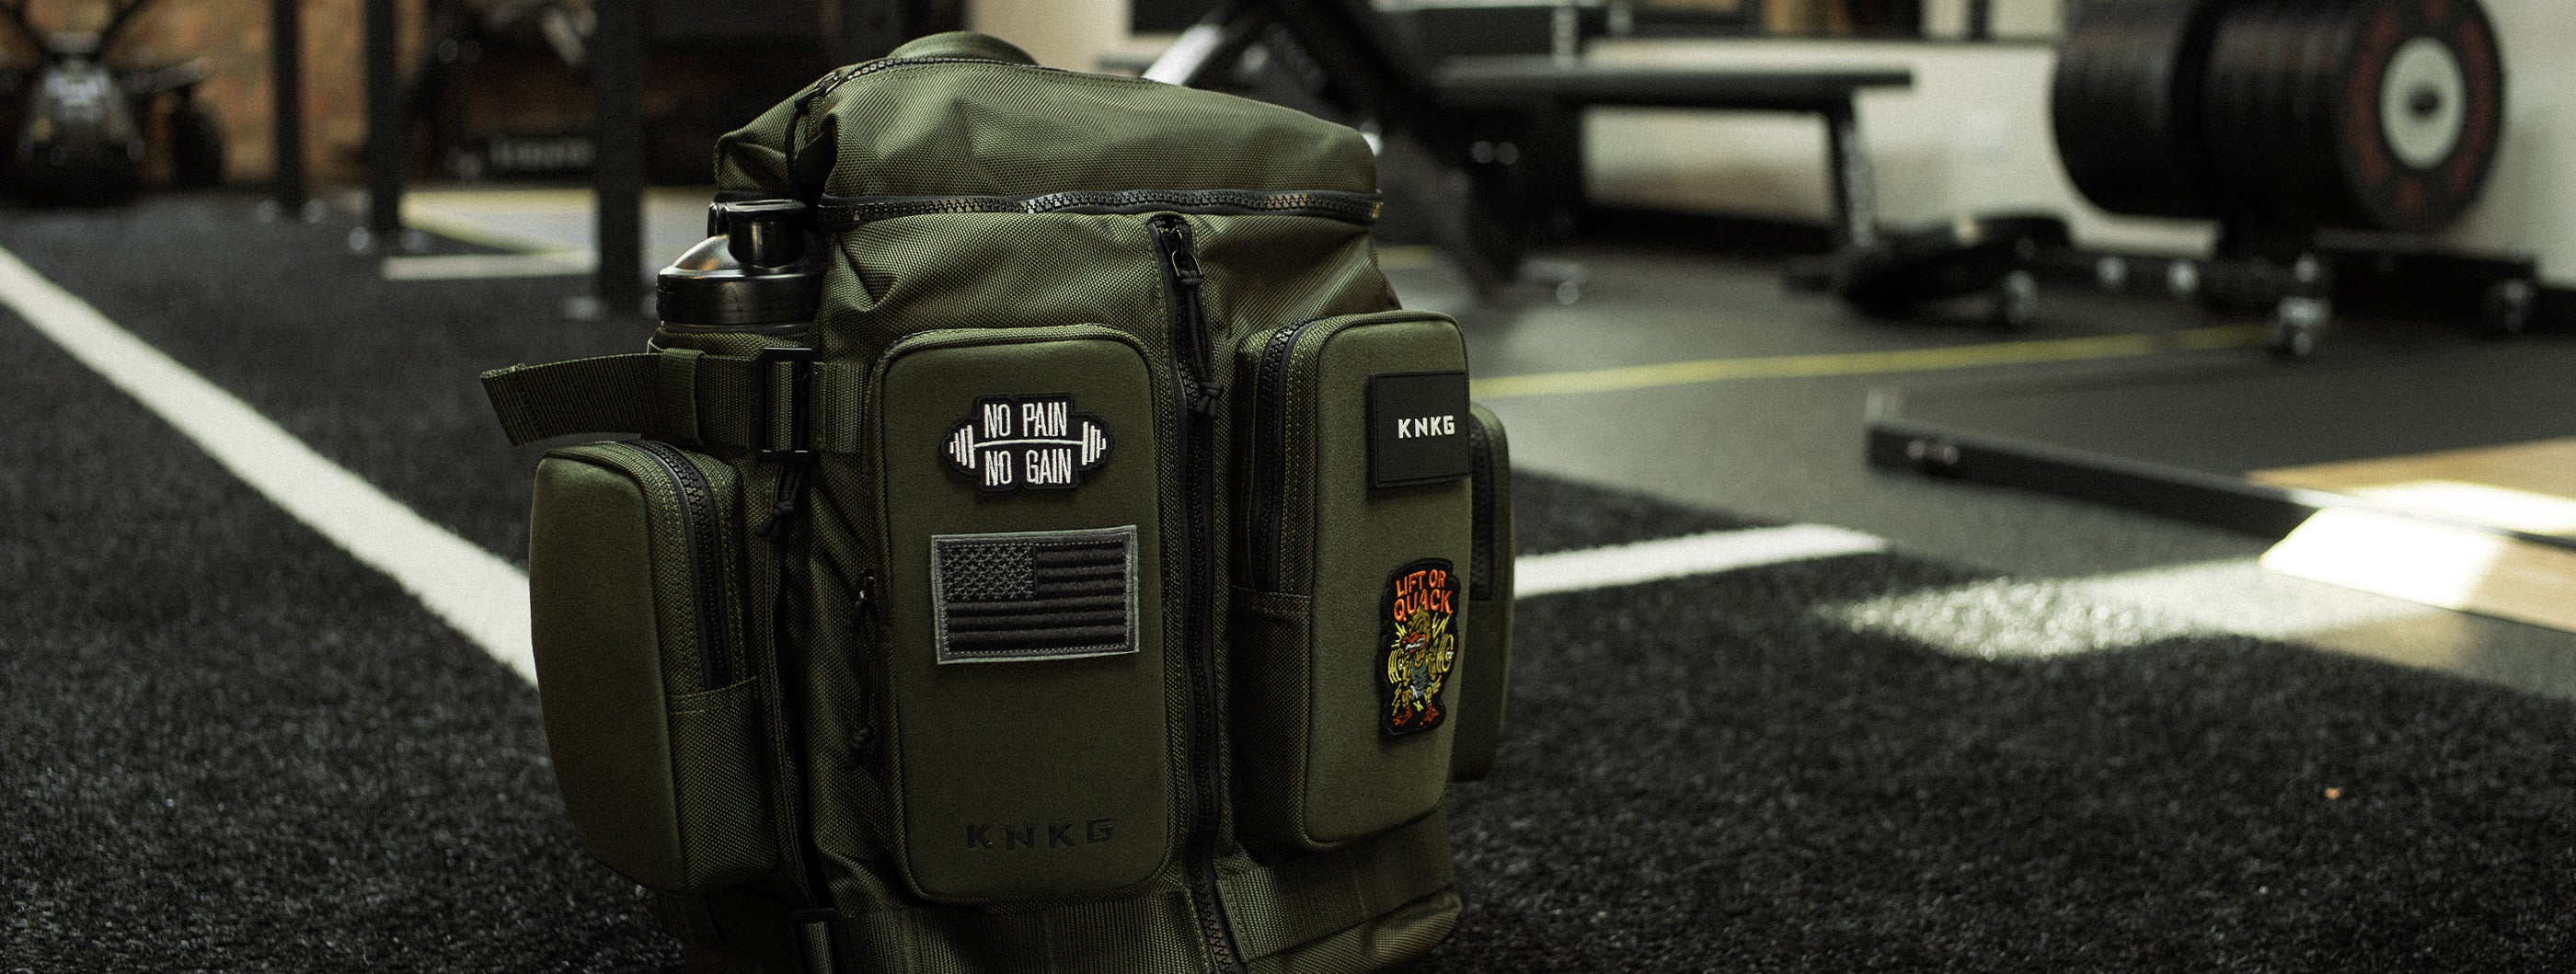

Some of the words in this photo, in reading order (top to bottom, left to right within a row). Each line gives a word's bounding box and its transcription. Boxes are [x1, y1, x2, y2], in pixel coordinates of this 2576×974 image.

[983, 403, 1012, 439] NO
[1022, 401, 1067, 438] PAIN
[1397, 415, 1455, 439] KNKG
[984, 450, 1013, 487] NO
[1025, 448, 1072, 485] GAIN
[1396, 569, 1427, 598] LIFT
[1429, 568, 1447, 589] OR
[1393, 588, 1454, 623] QUACK
[966, 816, 1113, 851] KNKG
